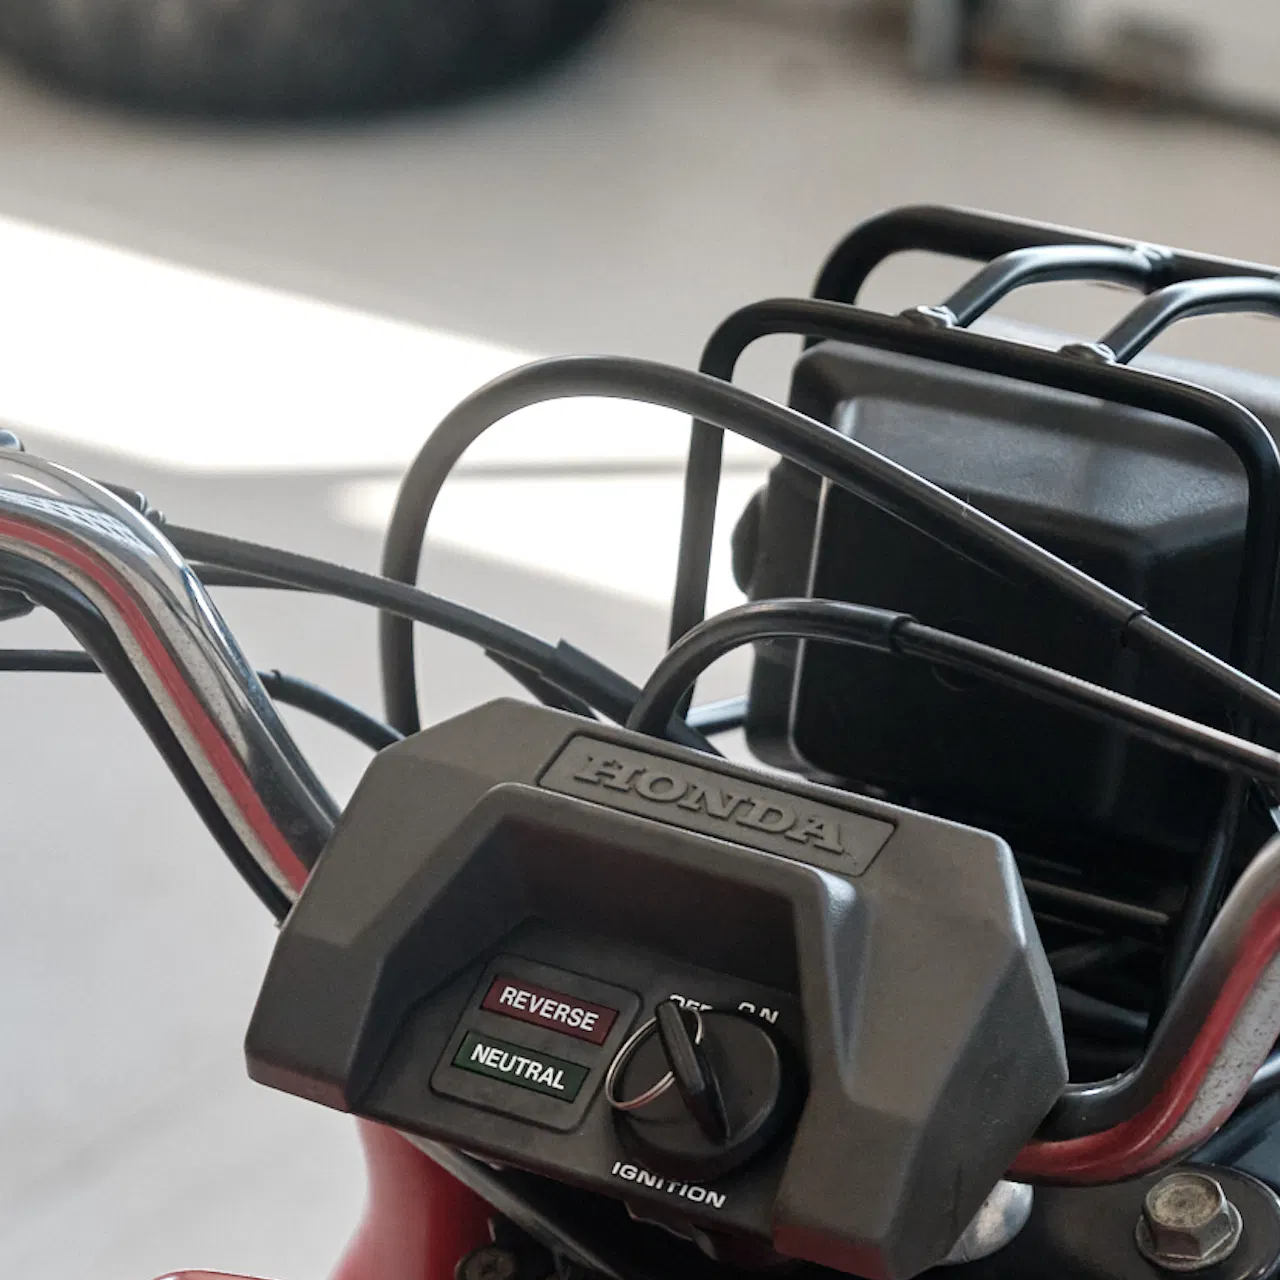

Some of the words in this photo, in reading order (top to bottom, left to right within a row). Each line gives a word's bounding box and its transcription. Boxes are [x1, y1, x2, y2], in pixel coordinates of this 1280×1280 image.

[572, 752, 846, 855] HONDA
[497, 986, 600, 1032] REVERSE
[470, 1043, 566, 1091] NEUTRAL
[611, 1160, 727, 1209] IGNITION
